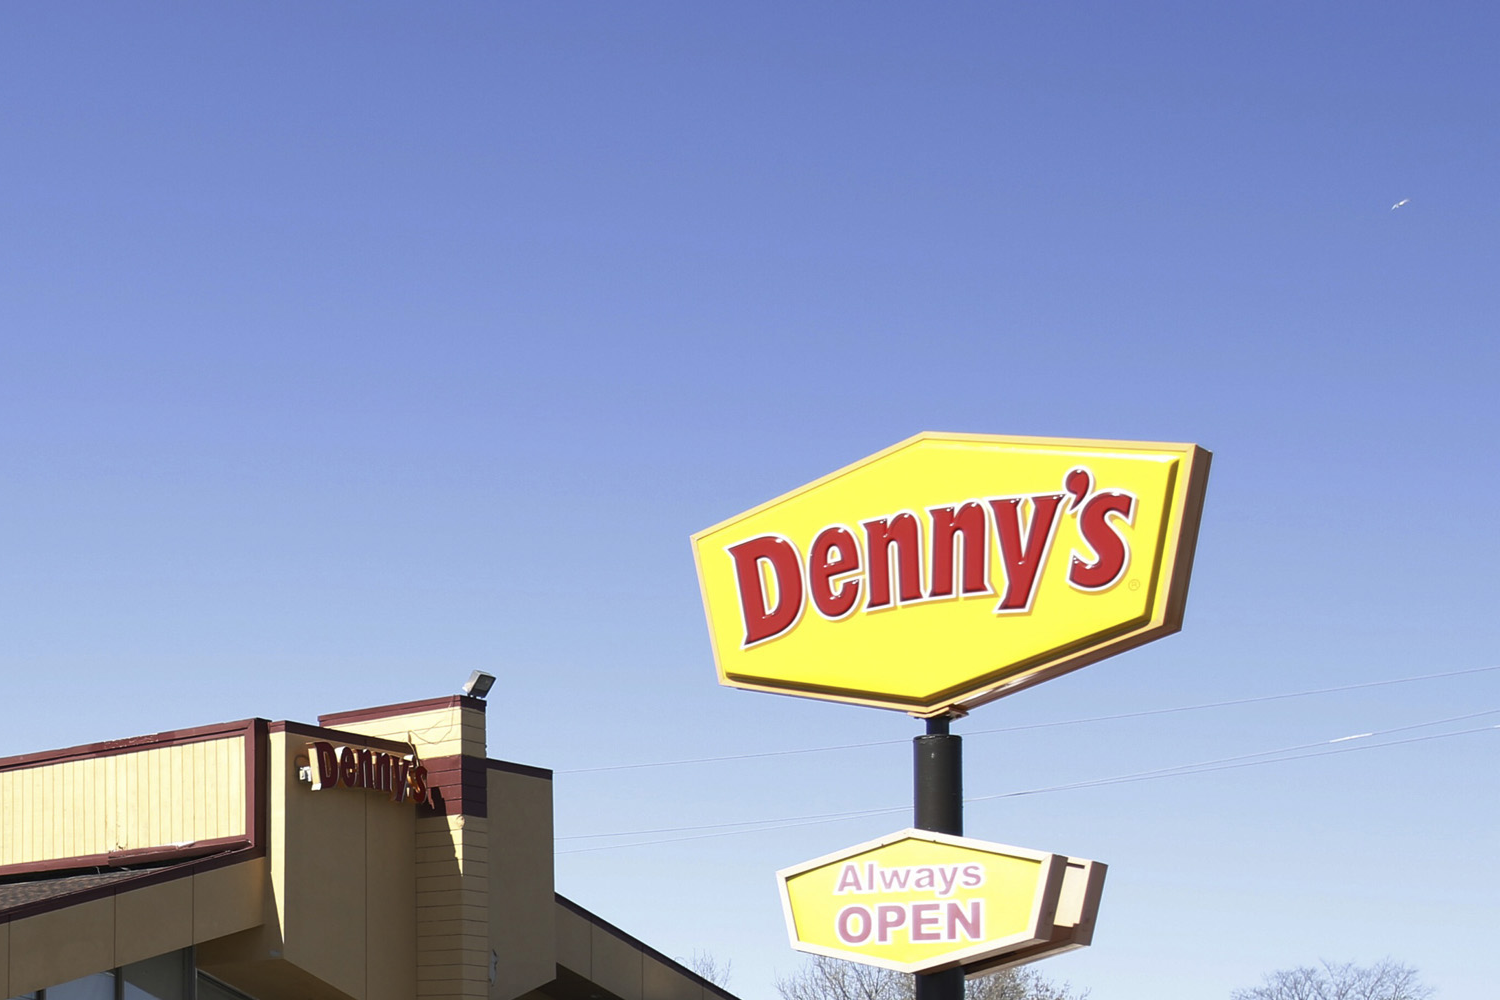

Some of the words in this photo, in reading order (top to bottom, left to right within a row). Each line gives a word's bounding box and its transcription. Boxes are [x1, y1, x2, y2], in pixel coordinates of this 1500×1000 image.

[725, 466, 1137, 649] Denny's
[308, 742, 428, 804] Denny's
[837, 863, 982, 896] Always
[837, 901, 981, 944] OPEN
